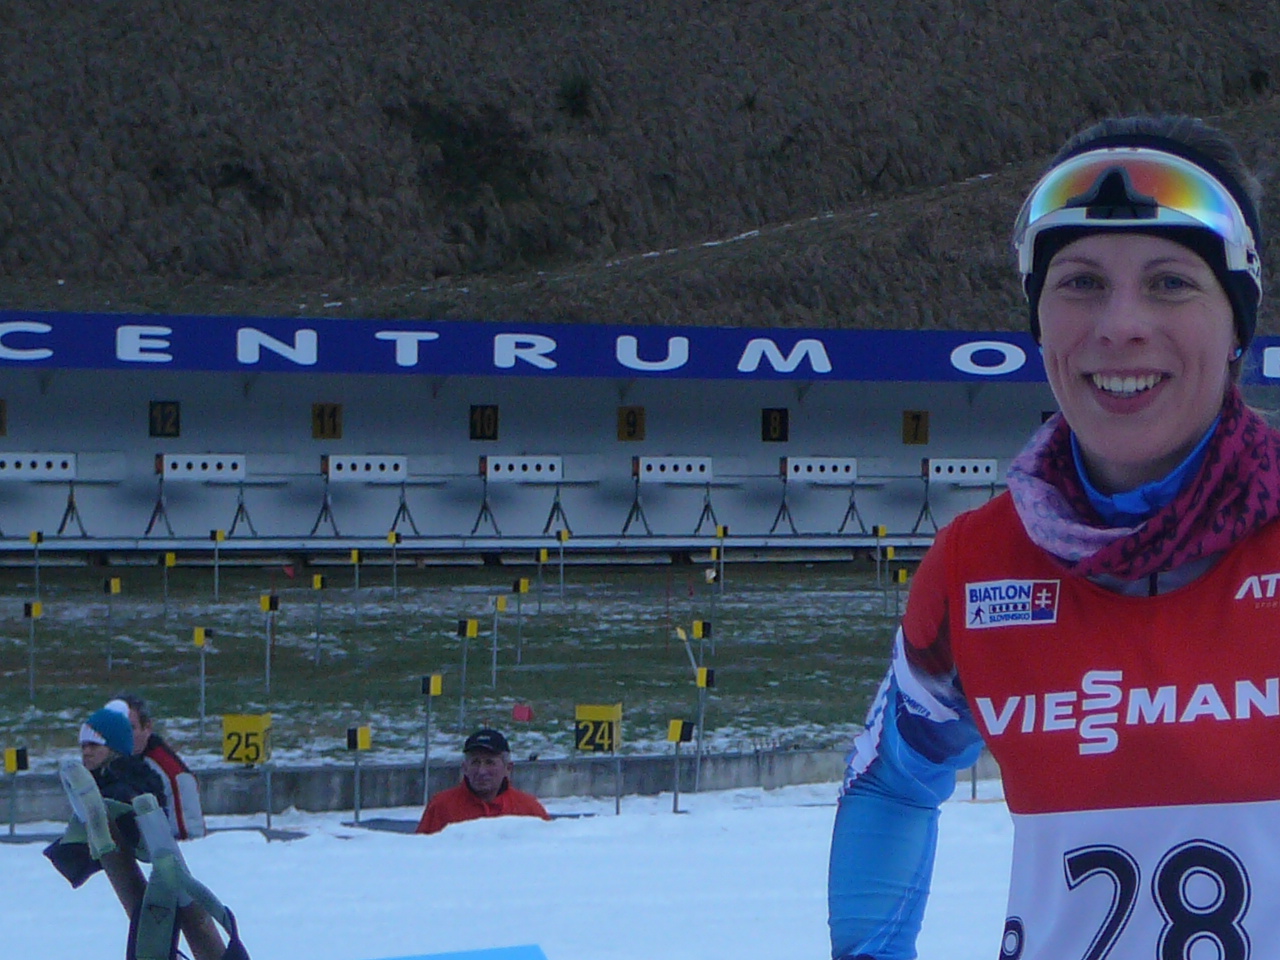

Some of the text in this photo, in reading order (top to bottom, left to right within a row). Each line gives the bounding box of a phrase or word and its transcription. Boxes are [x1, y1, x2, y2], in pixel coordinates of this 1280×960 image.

[0, 321, 833, 374] CENTRUM
[151, 404, 177, 433] 12
[316, 405, 338, 435] 11
[472, 407, 496, 437] 10
[625, 410, 638, 438] 9
[769, 410, 782, 439] 8
[911, 413, 923, 441] 7
[968, 584, 1032, 604] BIATLON
[989, 612, 1031, 623] SLOVENSKO
[226, 731, 261, 763] 25
[578, 719, 612, 750] 24
